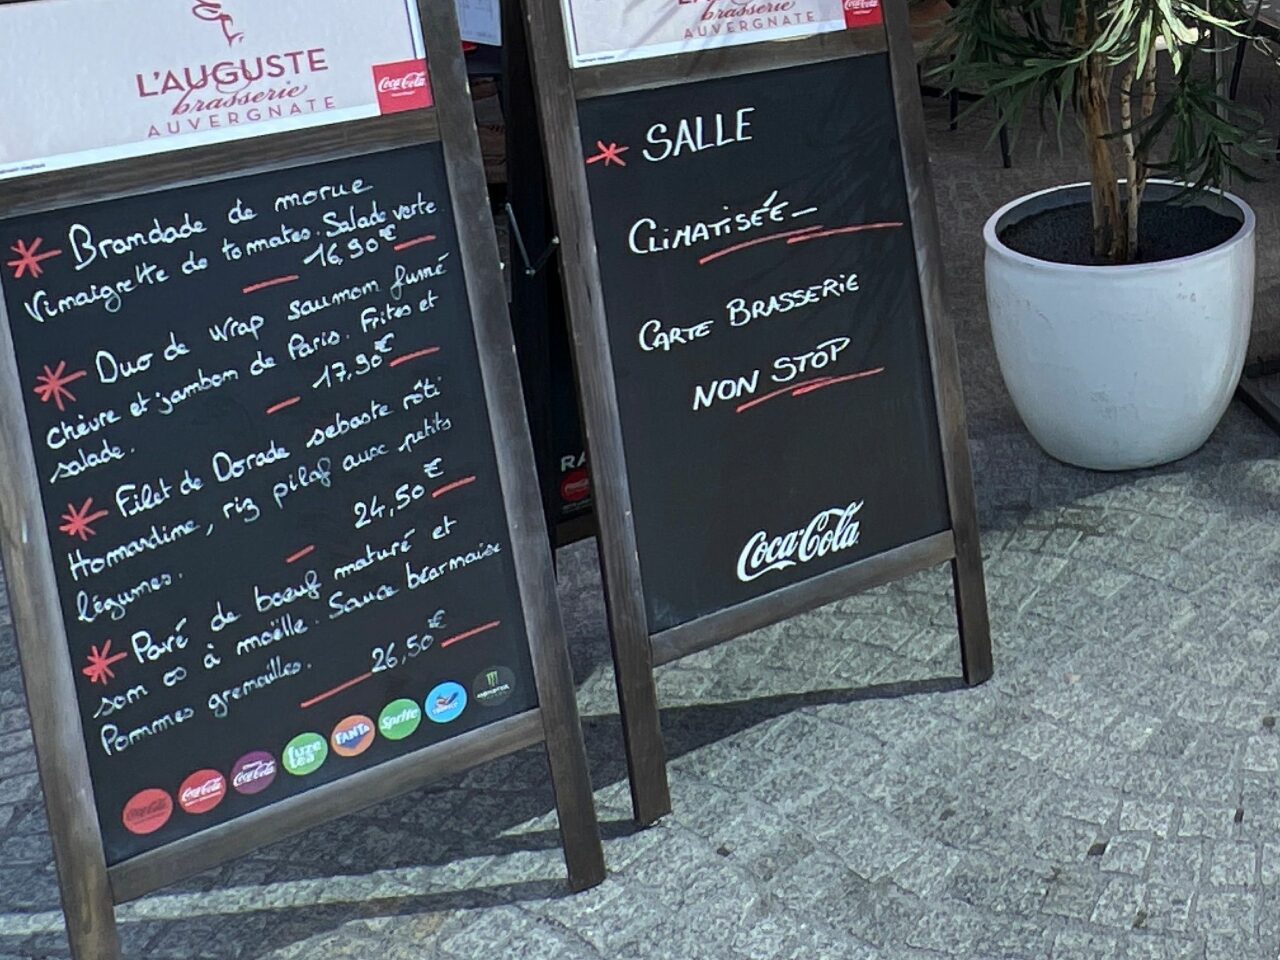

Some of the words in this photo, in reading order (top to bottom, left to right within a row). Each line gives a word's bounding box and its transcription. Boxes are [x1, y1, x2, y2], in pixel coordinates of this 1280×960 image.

[684, 11, 815, 39] AUVERGNATE
[136, 48, 328, 98] L'AUGUSTE
[171, 78, 308, 116] brasserie
[148, 95, 336, 138] AUVERGNATE
[642, 107, 755, 161] SALLE
[228, 198, 258, 224] de
[275, 178, 373, 212] morue
[181, 251, 208, 274] de
[393, 192, 437, 221] verte
[95, 350, 154, 383] Duo
[164, 331, 191, 361] de
[130, 392, 150, 416] et
[250, 351, 277, 375] de
[419, 290, 438, 312] et
[692, 370, 760, 411] NON
[770, 337, 851, 382] STOP
[115, 478, 172, 518] Filet
[180, 470, 203, 495] de
[212, 440, 290, 482] Dorade
[736, 498, 864, 582] Coca-Cola
[210, 601, 241, 631] de
[432, 515, 457, 540] et
[100, 707, 194, 756] Pommes
[381, 708, 418, 730] Sprite
